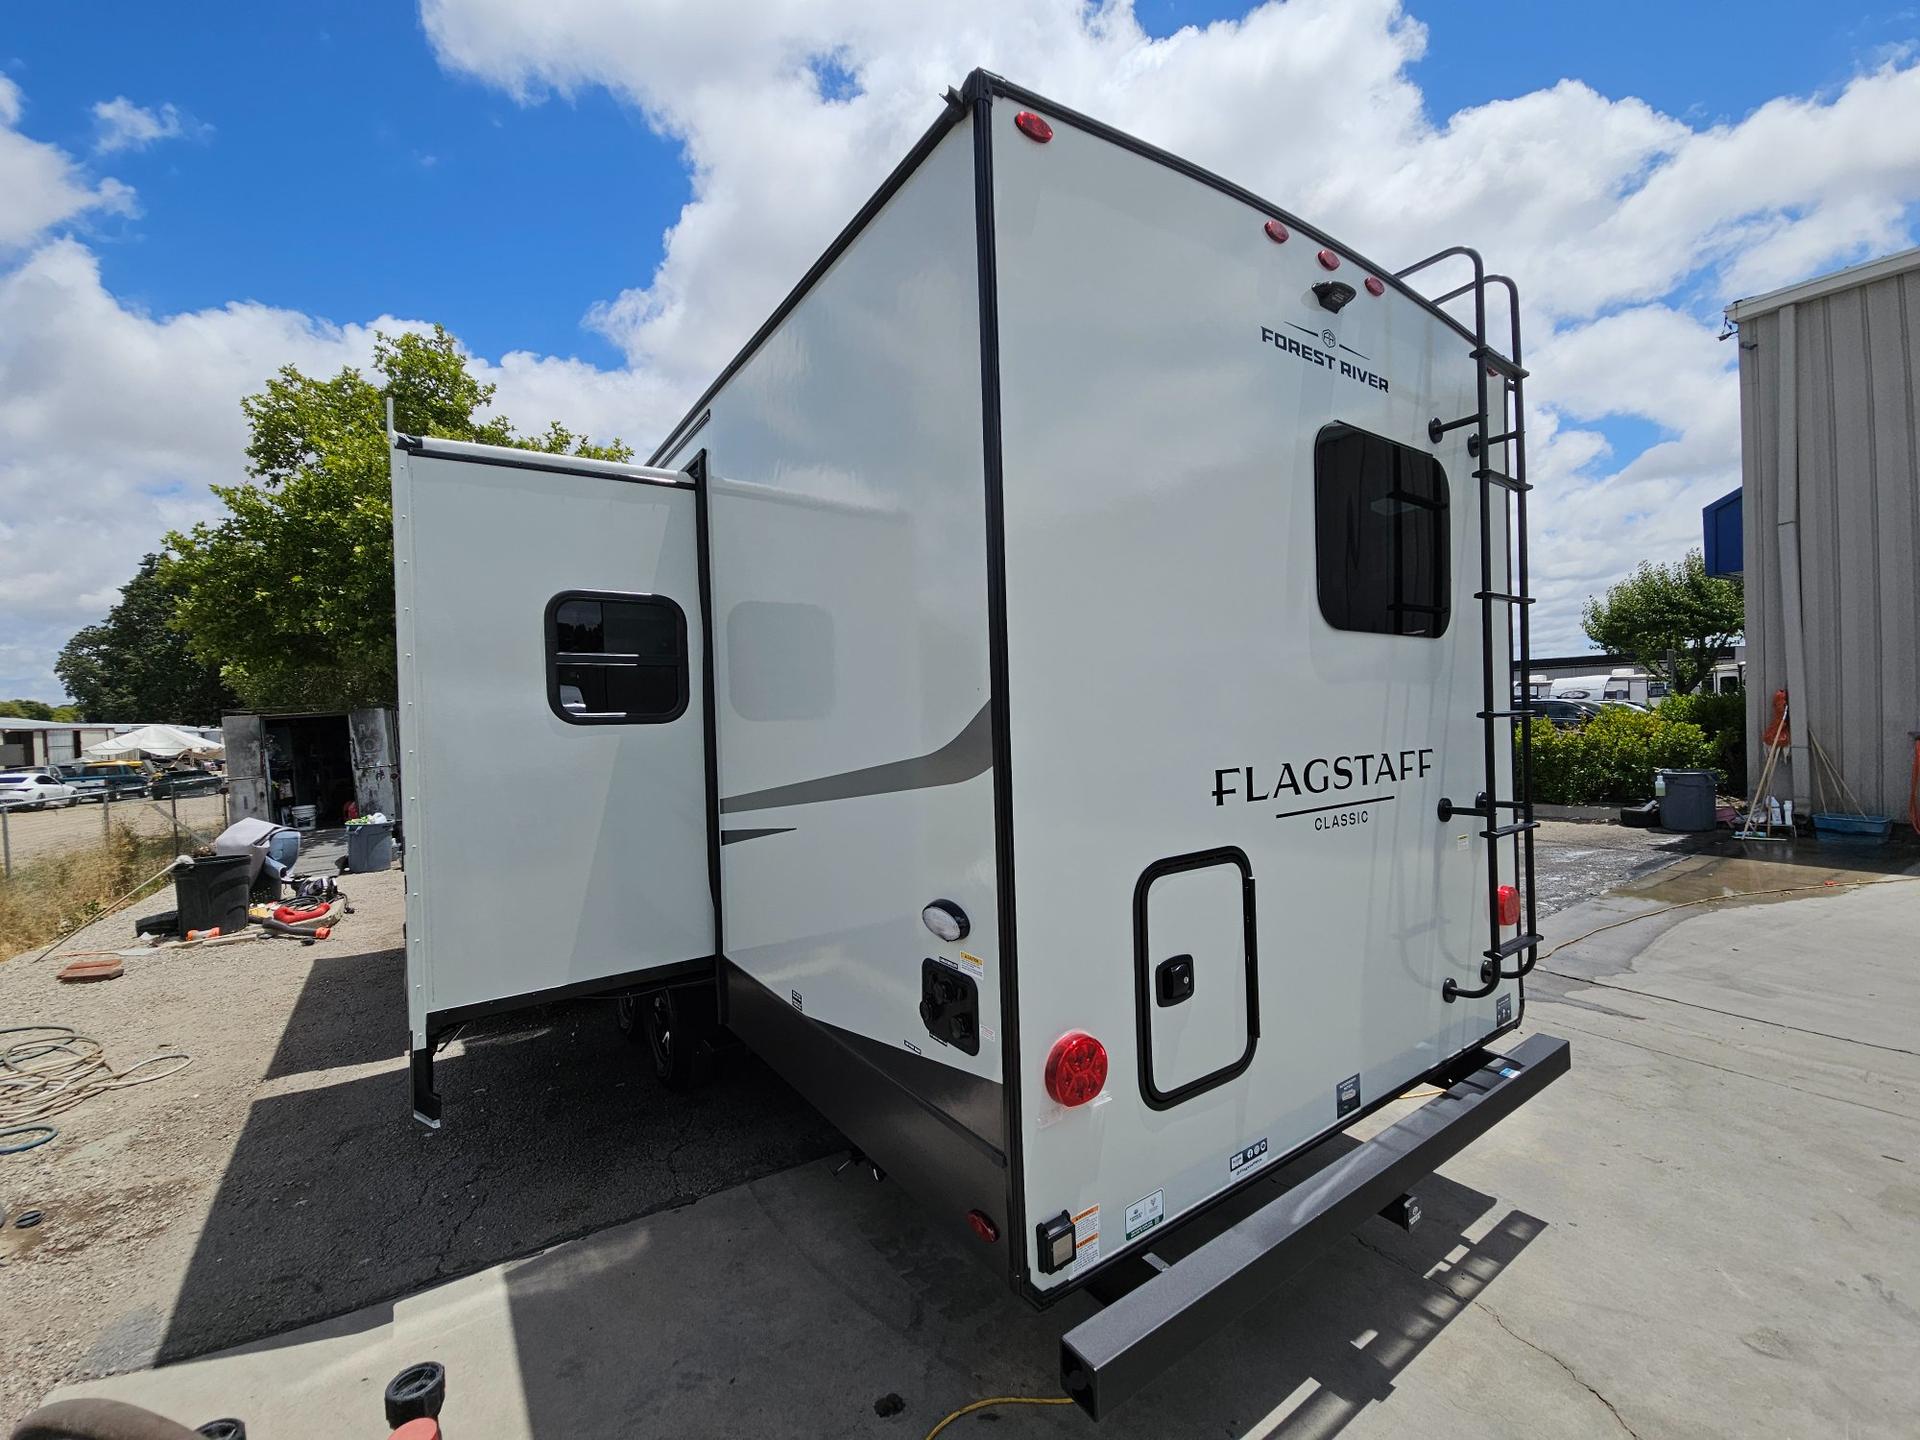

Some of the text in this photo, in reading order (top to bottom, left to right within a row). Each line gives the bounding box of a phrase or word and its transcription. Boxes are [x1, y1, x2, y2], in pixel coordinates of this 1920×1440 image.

[1260, 326, 1389, 393] FOREST RIVER
[1211, 748, 1434, 806] FLAGSTAFF
[1314, 810, 1369, 831] CLASSIC
